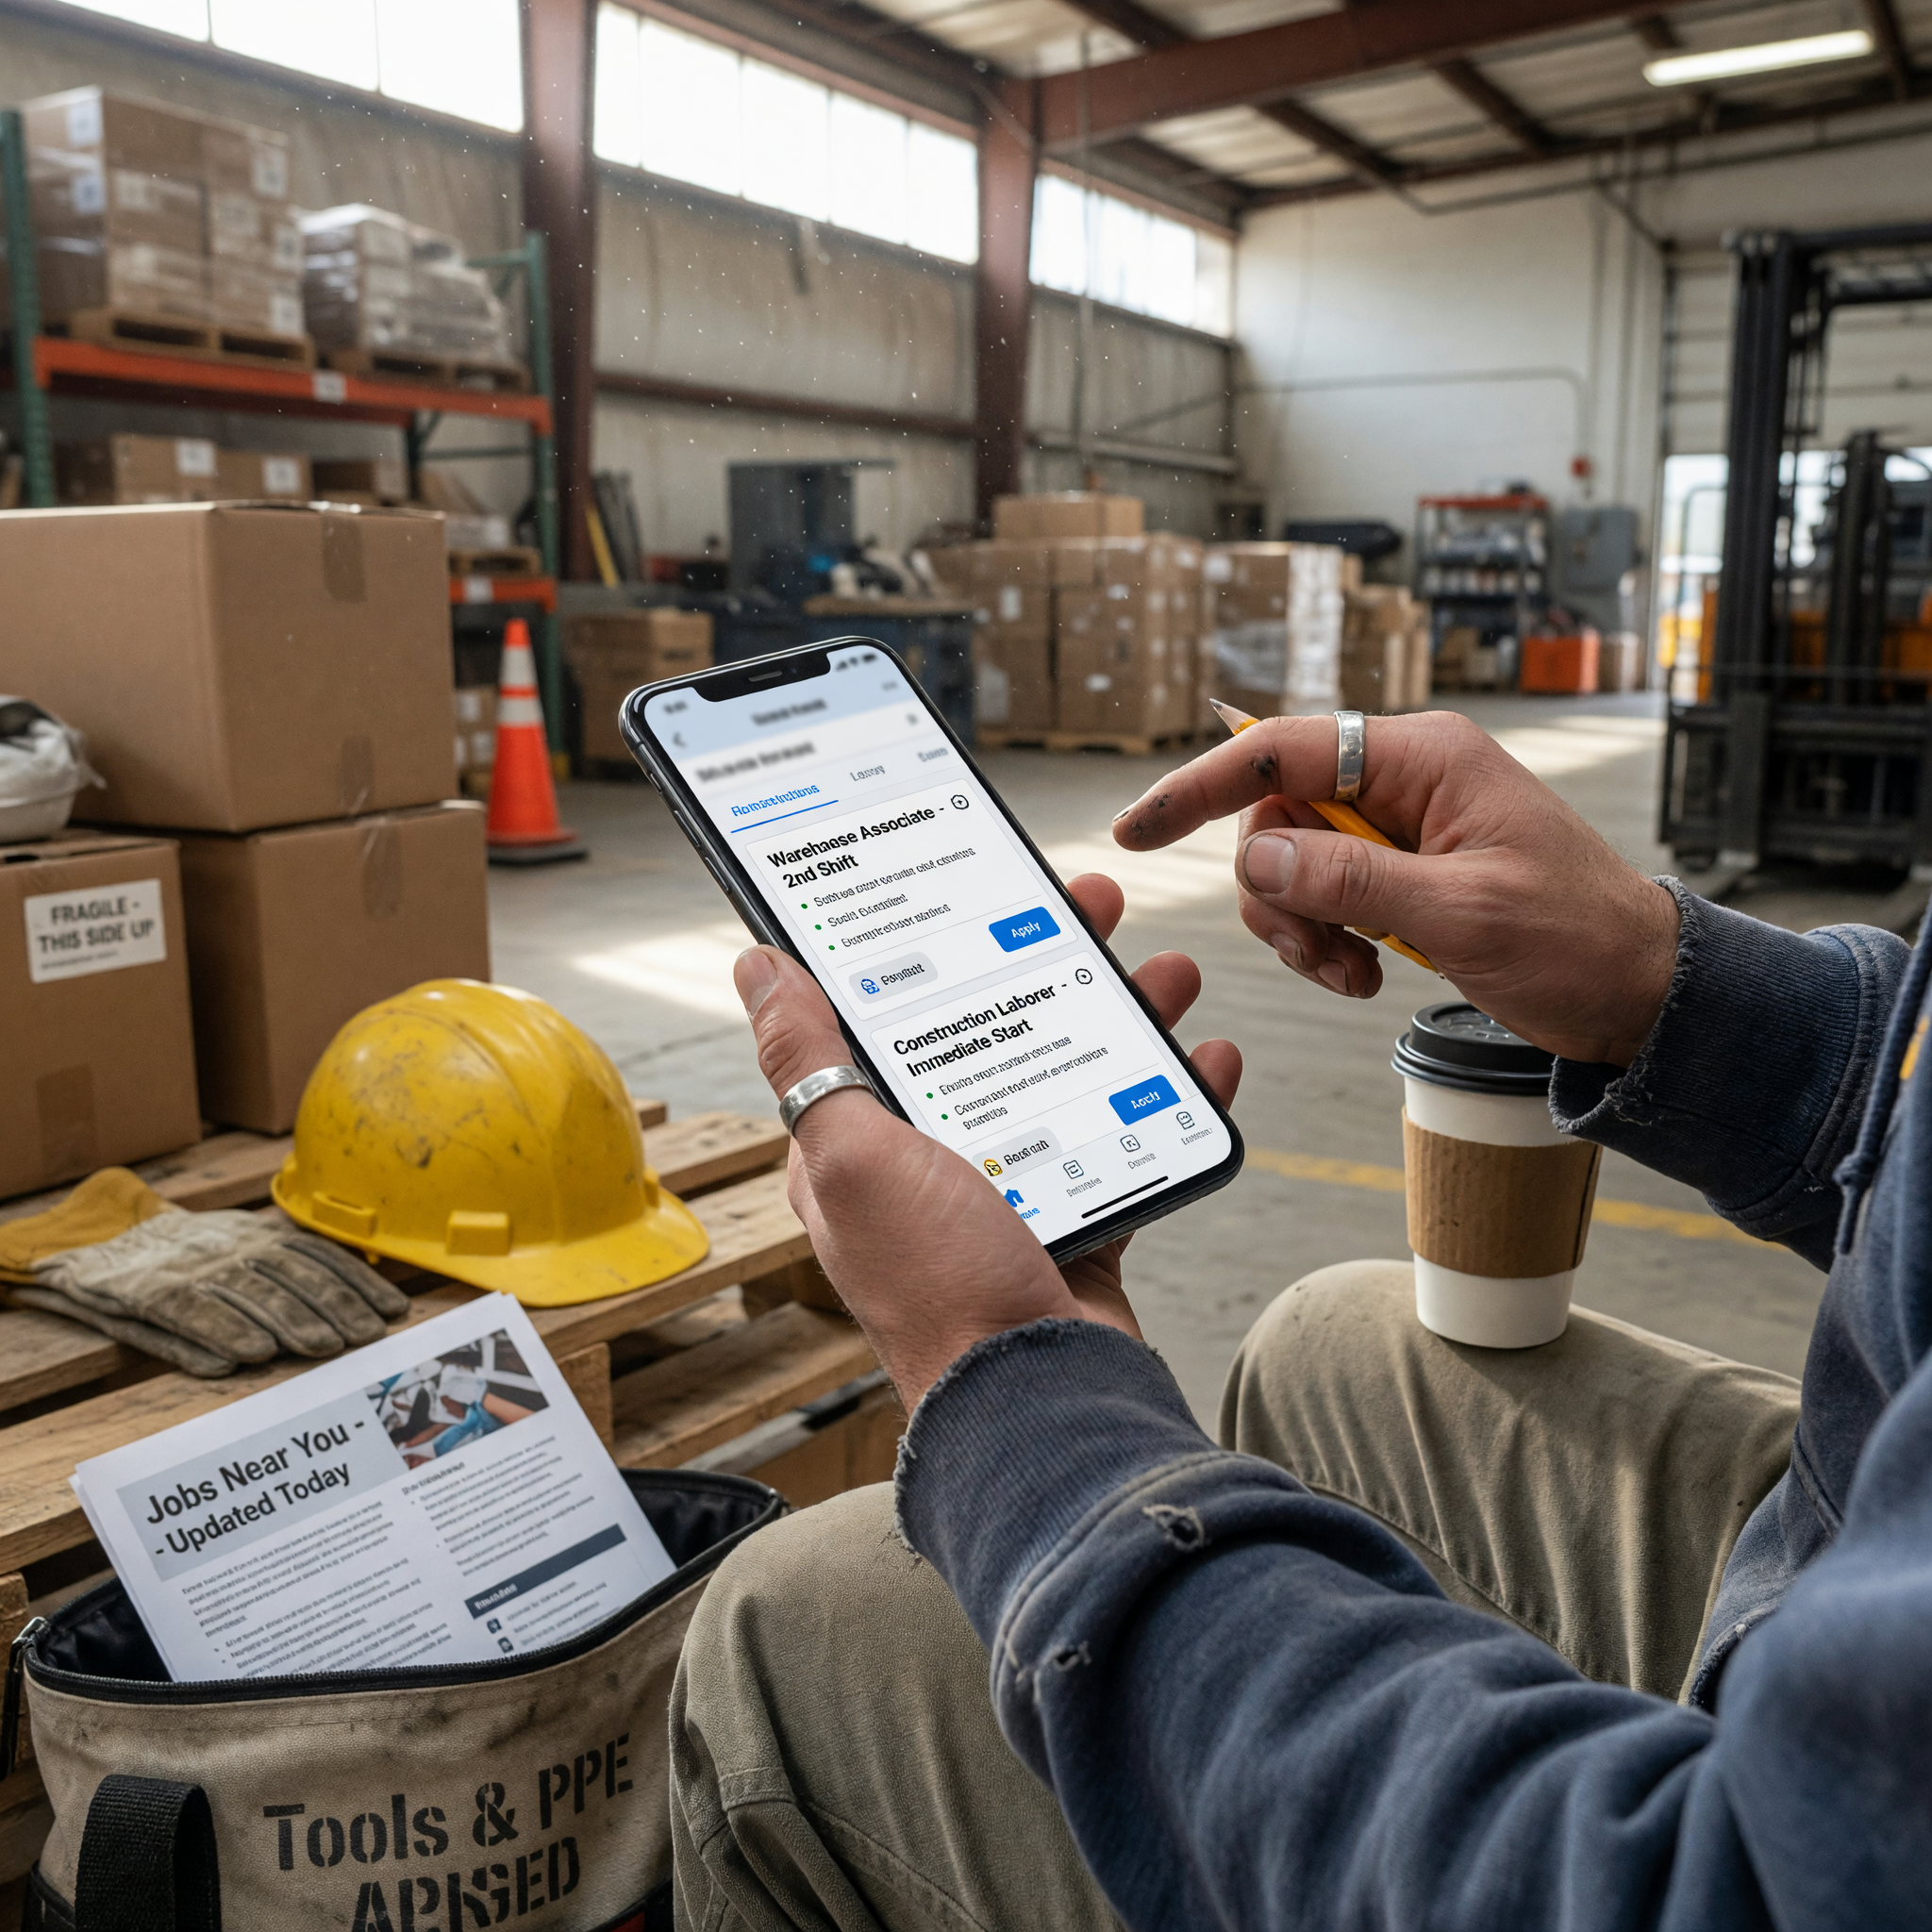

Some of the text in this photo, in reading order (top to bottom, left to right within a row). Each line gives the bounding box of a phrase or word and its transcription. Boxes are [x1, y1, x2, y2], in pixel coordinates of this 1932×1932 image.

[860, 808, 936, 840] Associate
[783, 854, 859, 889] 2nd Shift
[51, 896, 128, 925] FRAGILE
[38, 918, 154, 953] THIS SIDE UP
[893, 1008, 997, 1056] Construction
[995, 985, 1056, 1017] Laborer
[906, 1037, 992, 1077] Immediate
[991, 1019, 1034, 1043] Start
[146, 1478, 219, 1525] Jobs
[219, 1447, 291, 1492] Near
[291, 1421, 350, 1458] You
[275, 1461, 351, 1507] Today
[262, 1732, 633, 1872] Tools & PPE
